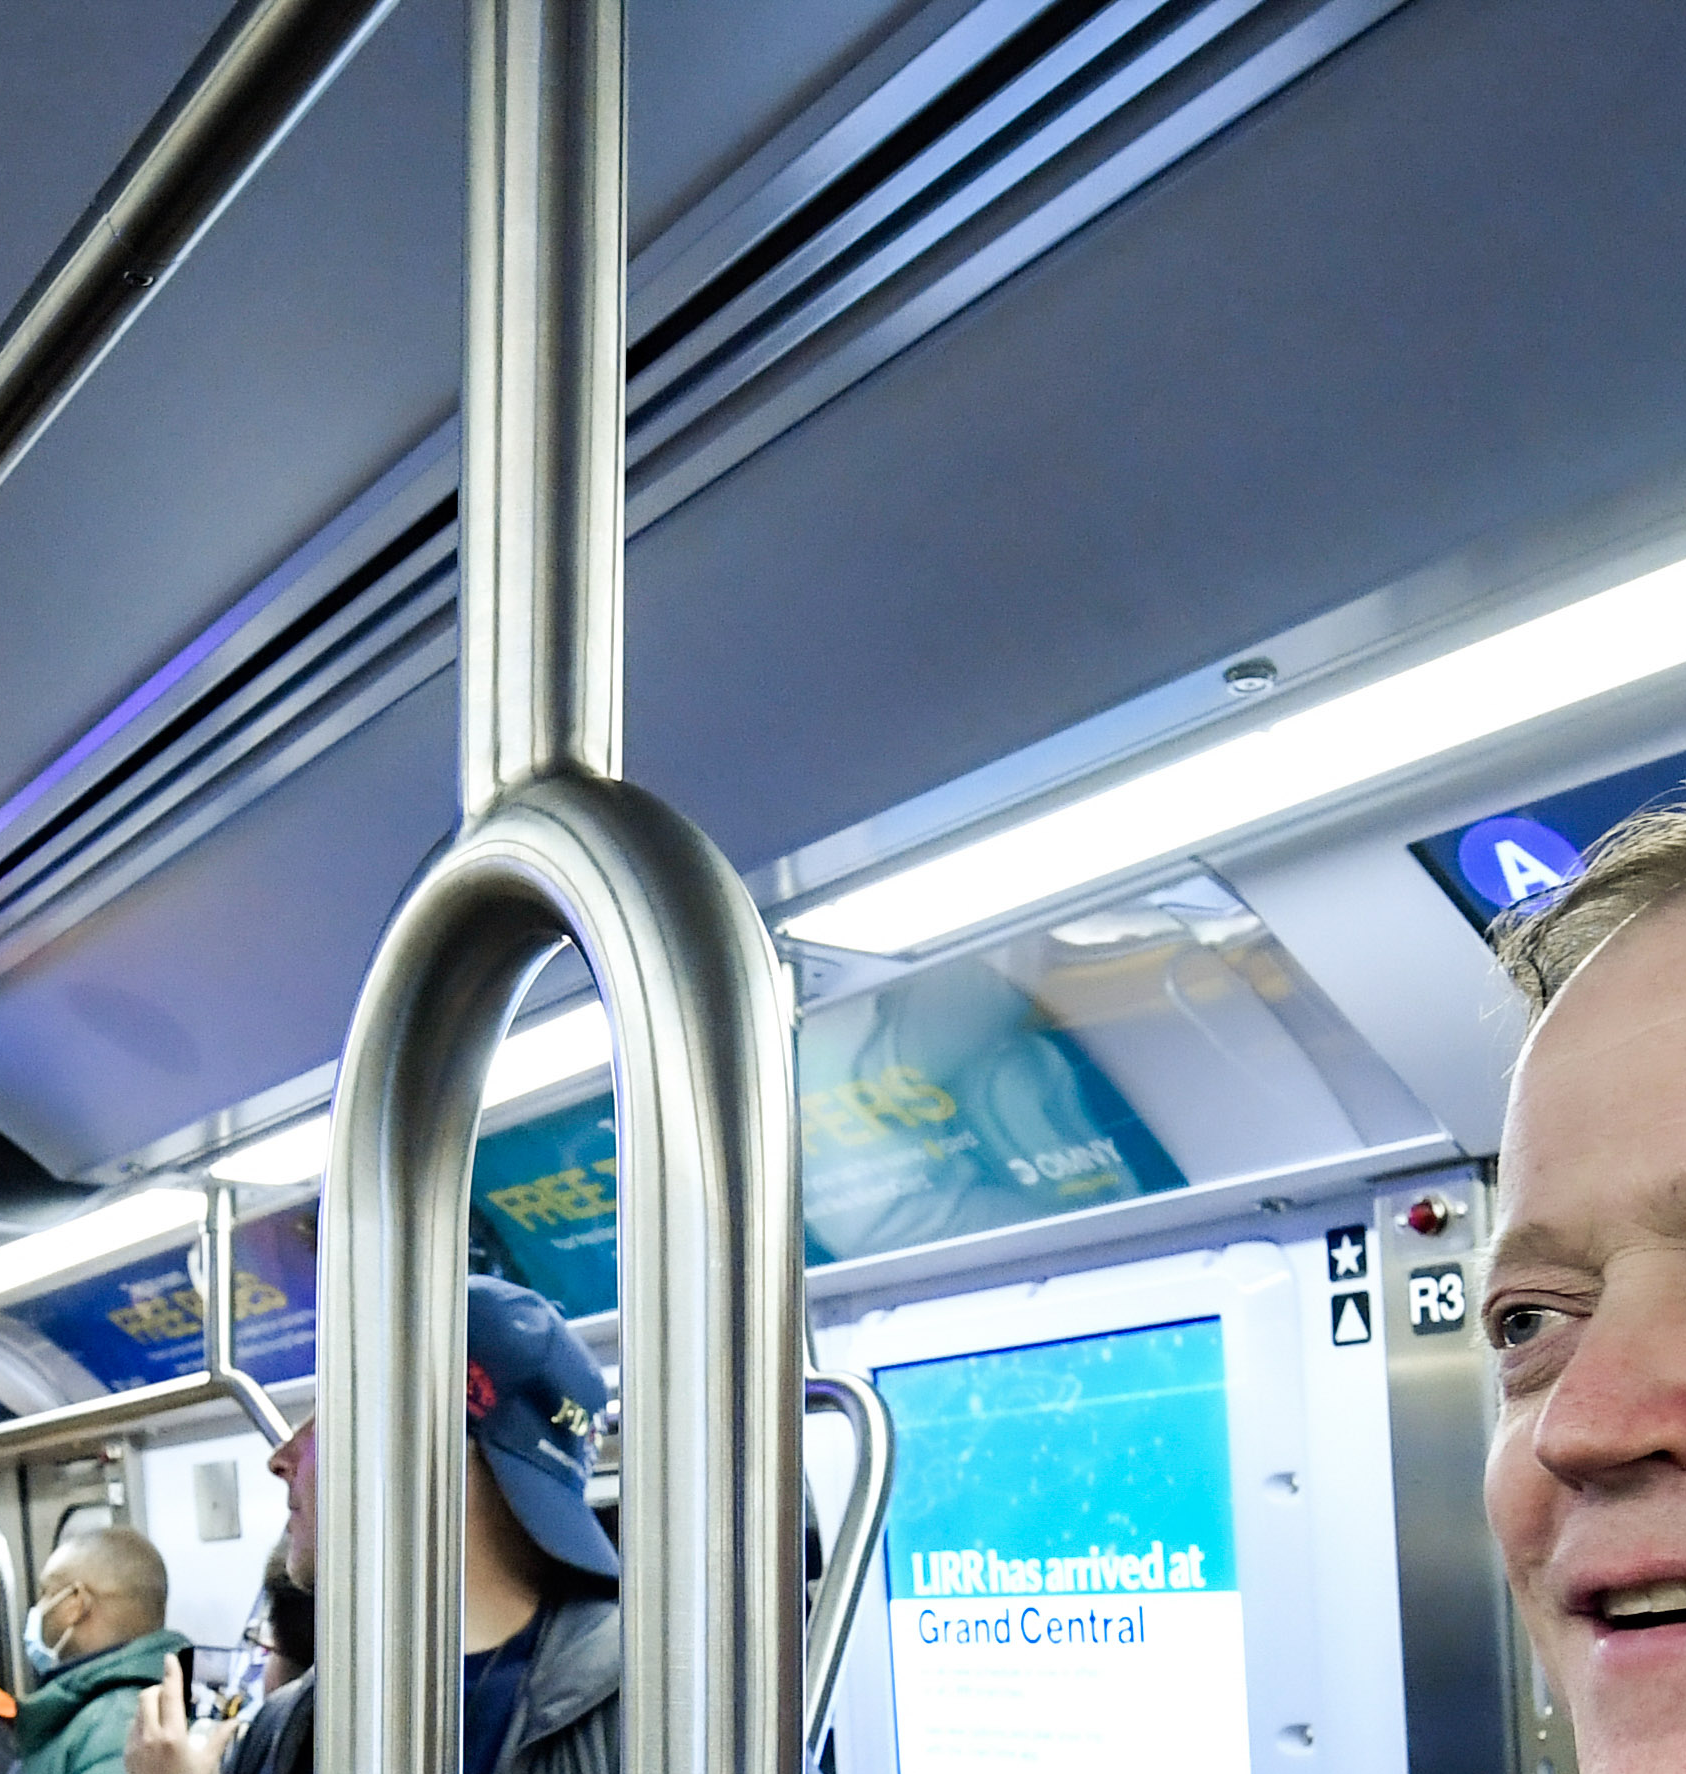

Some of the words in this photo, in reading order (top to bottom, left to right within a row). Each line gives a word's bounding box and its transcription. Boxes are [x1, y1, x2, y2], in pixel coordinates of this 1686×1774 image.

[1494, 838, 1563, 904] A
[1409, 1272, 1465, 1325] R3
[911, 1549, 987, 1596] LIRR
[988, 1548, 1043, 1594] has
[1045, 1545, 1165, 1592] arrived
[1168, 1544, 1206, 1589] at
[919, 1609, 1011, 1644] Grand
[1020, 1605, 1145, 1644] Central
